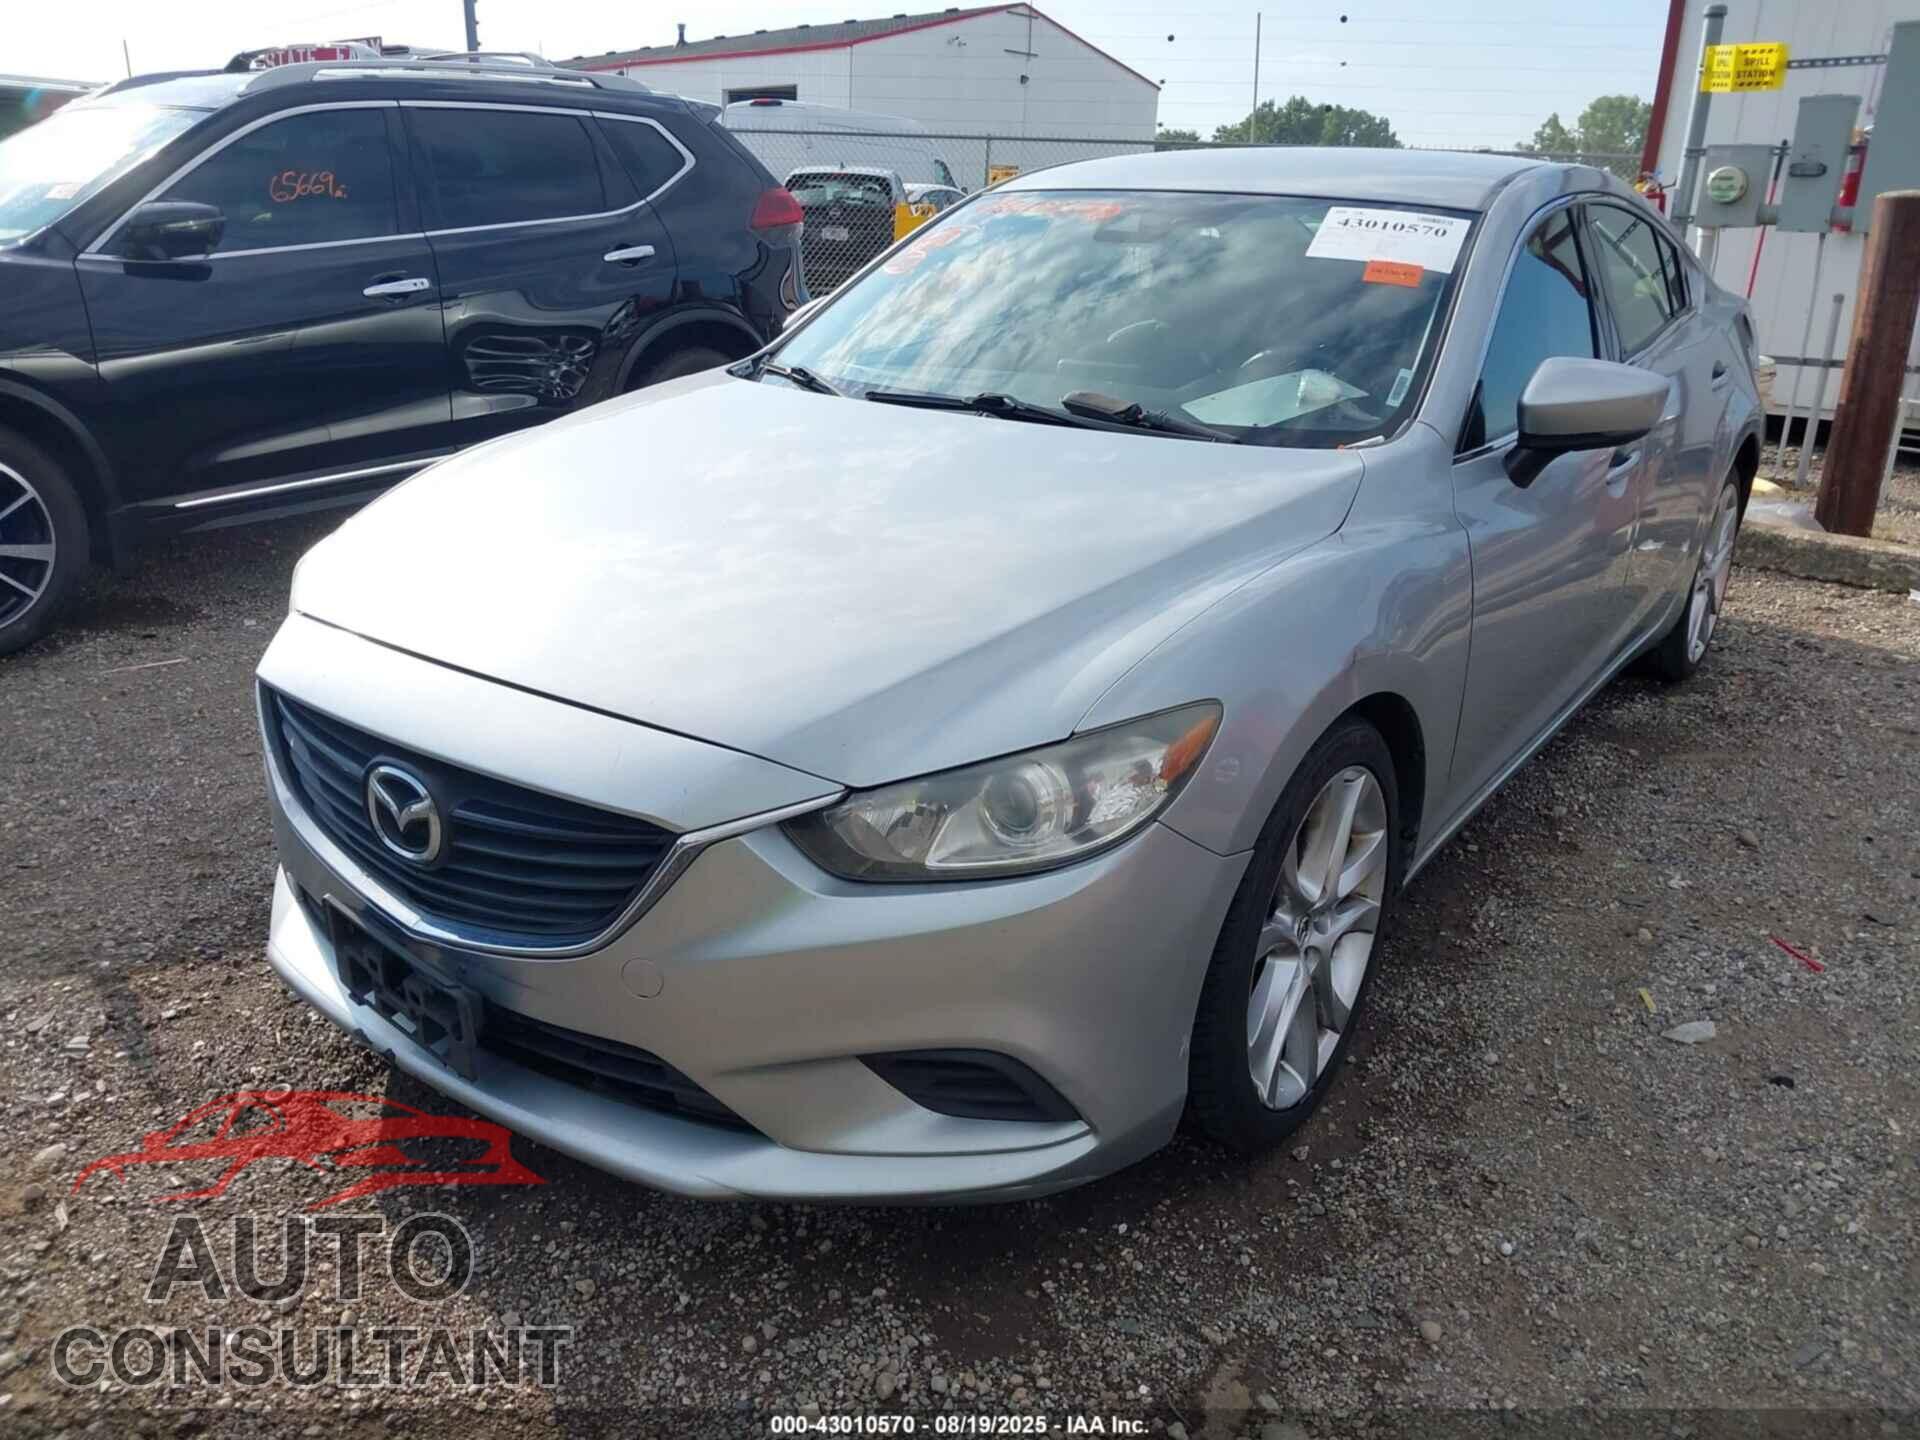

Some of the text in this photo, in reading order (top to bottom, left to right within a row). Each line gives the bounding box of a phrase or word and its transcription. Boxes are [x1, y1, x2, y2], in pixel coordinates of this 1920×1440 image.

[1743, 57, 1771, 66] SPILL
[1735, 70, 1776, 79] STATION
[270, 171, 334, 202] 65669
[1337, 216, 1448, 238] 43010570
